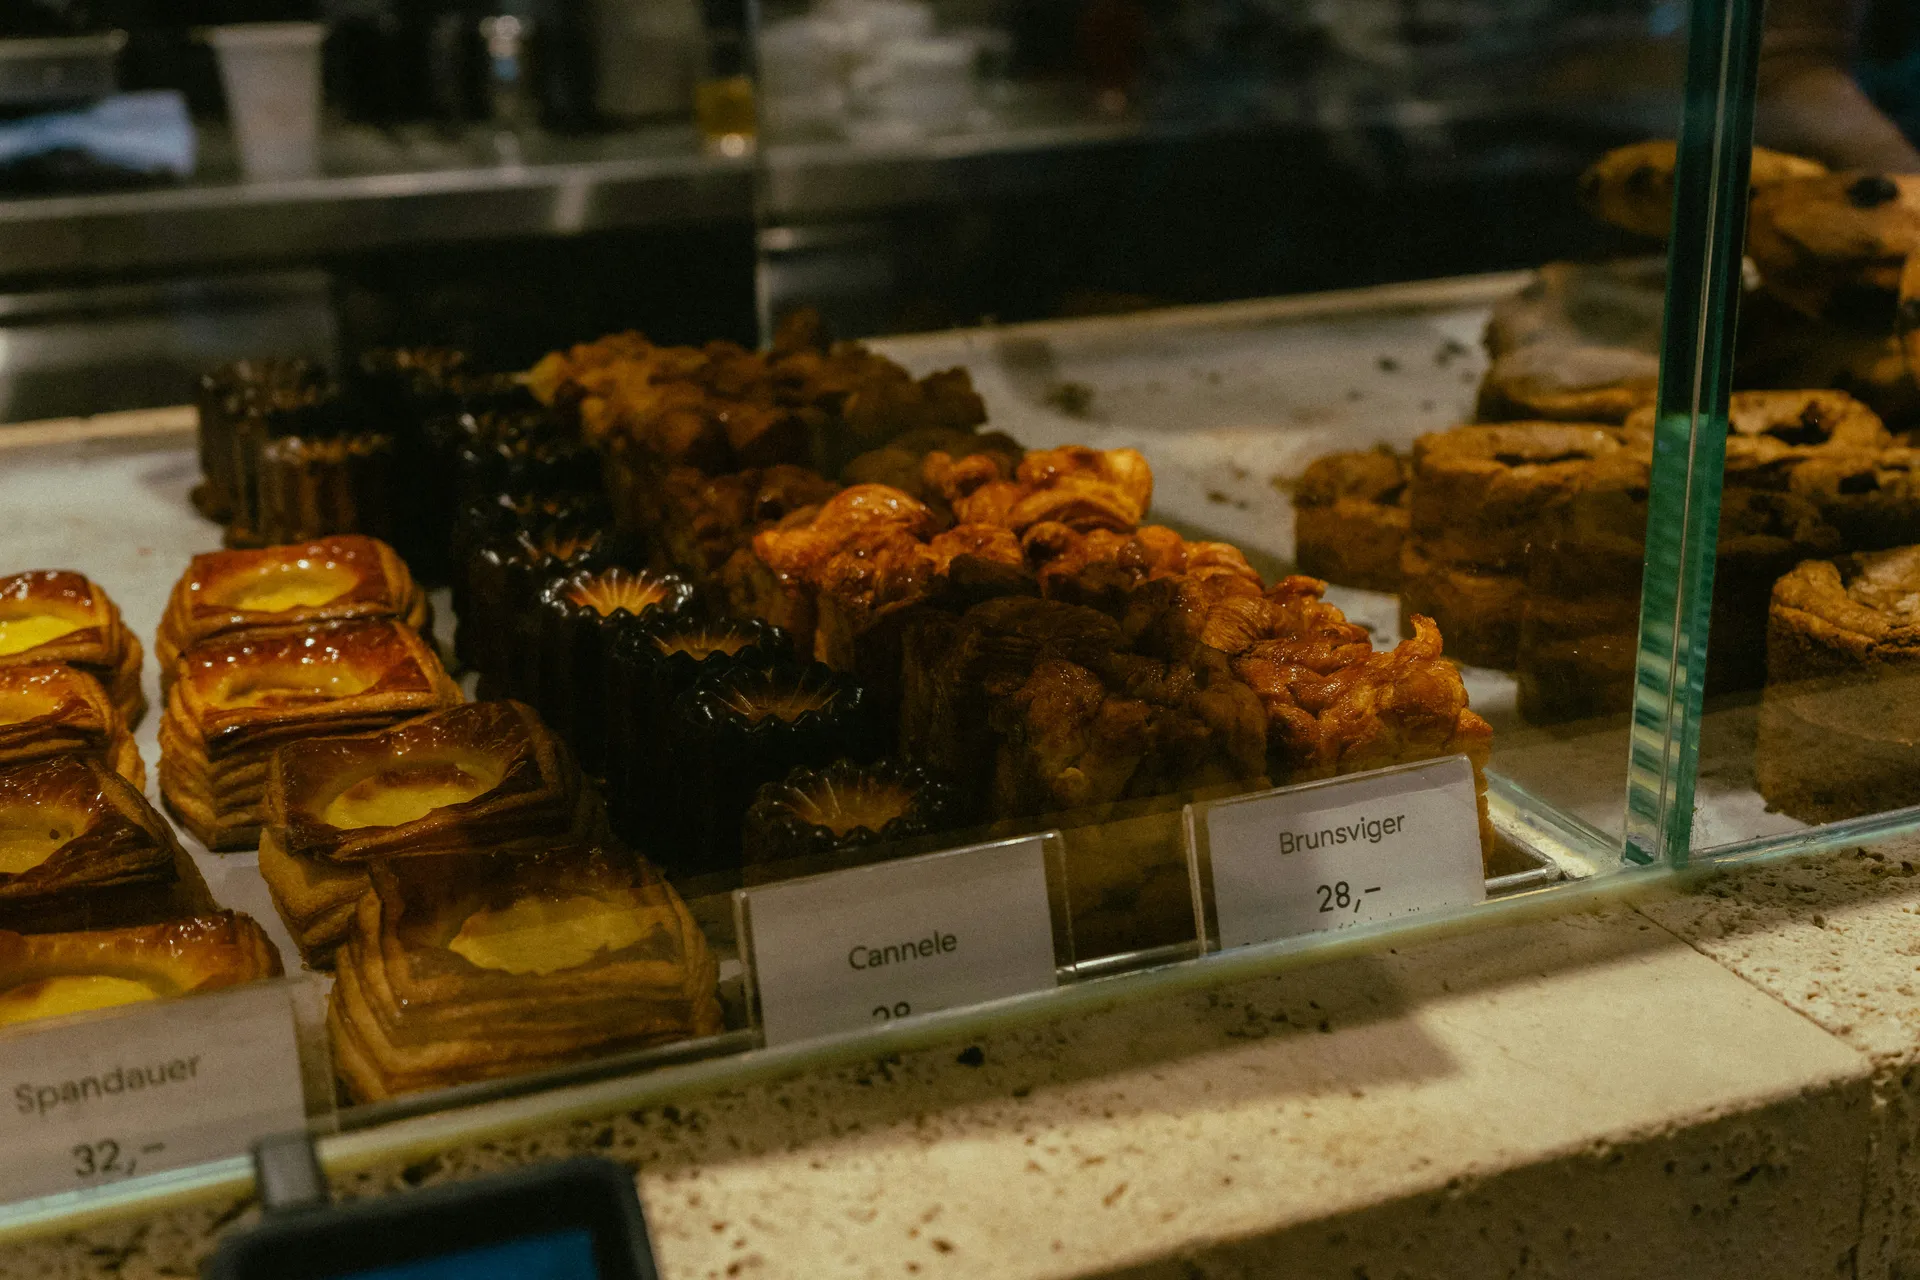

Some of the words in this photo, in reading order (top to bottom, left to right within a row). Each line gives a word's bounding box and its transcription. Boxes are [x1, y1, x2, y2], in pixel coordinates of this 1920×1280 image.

[1279, 814, 1405, 855] Brunsviger
[1316, 881, 1381, 913] 28,-
[848, 930, 958, 970] Cannele
[13, 1054, 200, 1116] Spandauer
